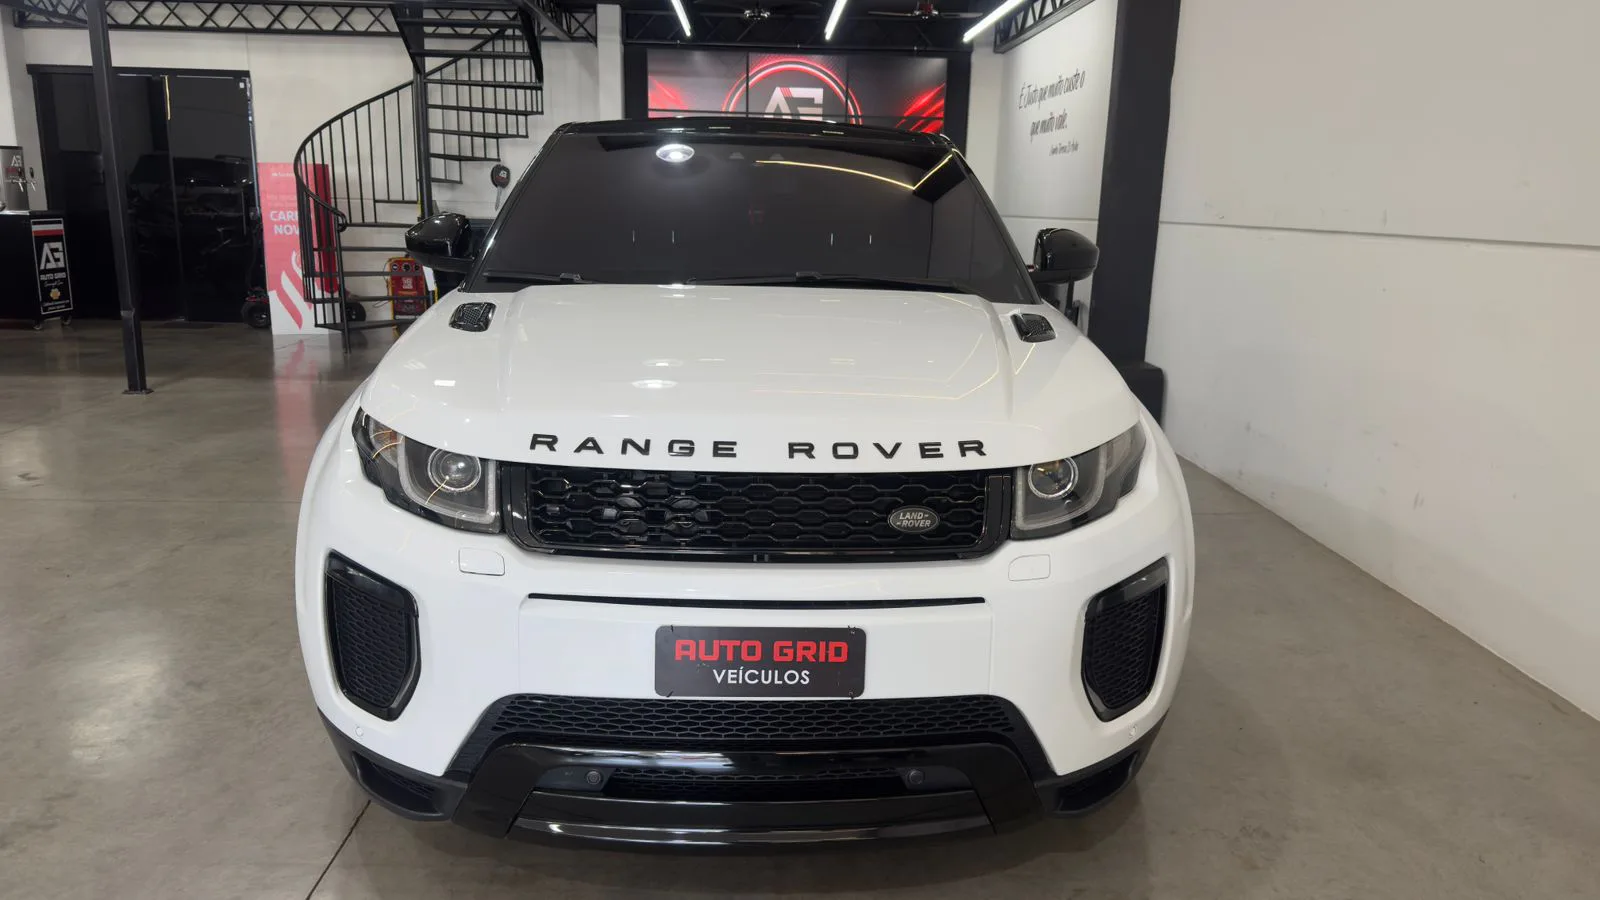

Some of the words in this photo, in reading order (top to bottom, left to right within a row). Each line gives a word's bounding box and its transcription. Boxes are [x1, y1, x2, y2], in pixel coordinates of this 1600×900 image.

[1038, 85, 1048, 110] que
[530, 433, 738, 459] RANGE
[788, 440, 988, 460] ROVER
[675, 639, 763, 662] AUTO
[773, 641, 849, 663] GRID
[712, 666, 811, 685] VEÍCULOS
